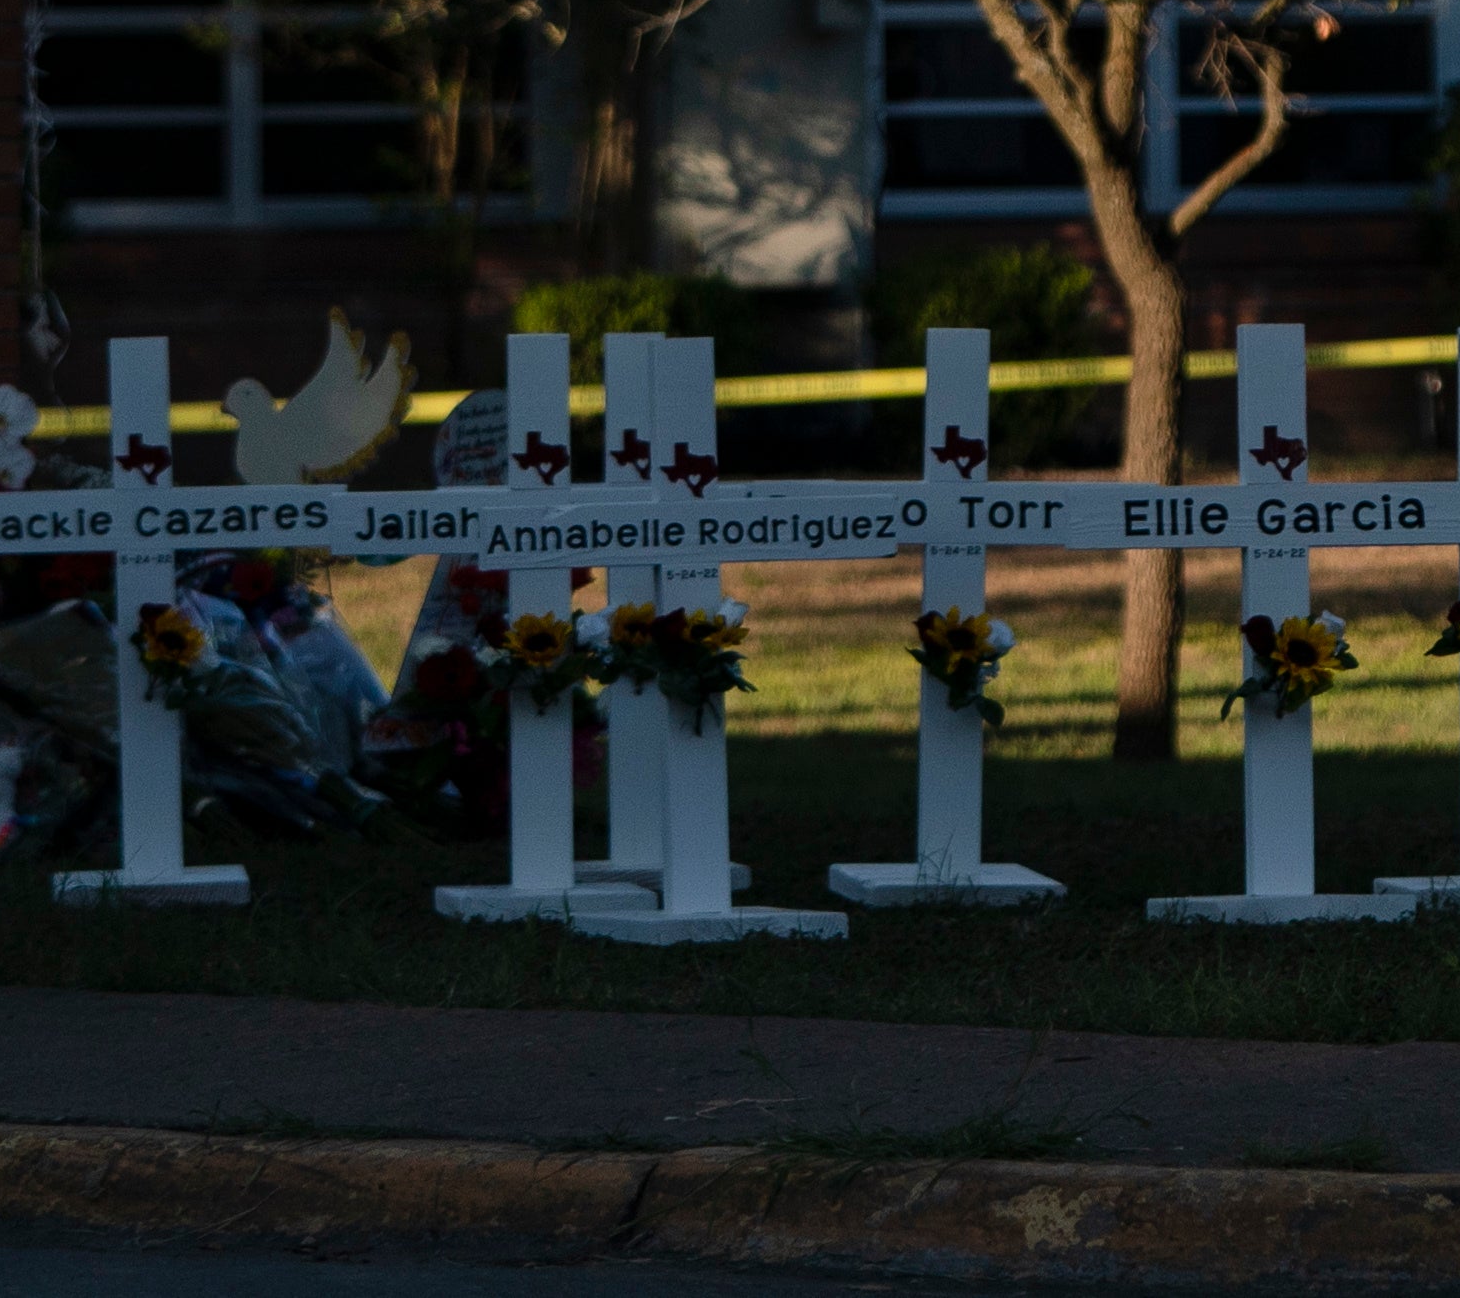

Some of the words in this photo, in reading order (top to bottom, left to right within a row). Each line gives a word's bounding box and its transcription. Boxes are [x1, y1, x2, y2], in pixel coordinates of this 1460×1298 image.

[134, 500, 329, 538] Cazares
[486, 518, 686, 555] Annabelle
[698, 514, 896, 549] Rodriguez
[1123, 497, 1229, 537] Ellie
[1256, 494, 1426, 536] Garcia
[1253, 548, 1306, 559] 5-24-22
[666, 568, 719, 580] 5-24-22
